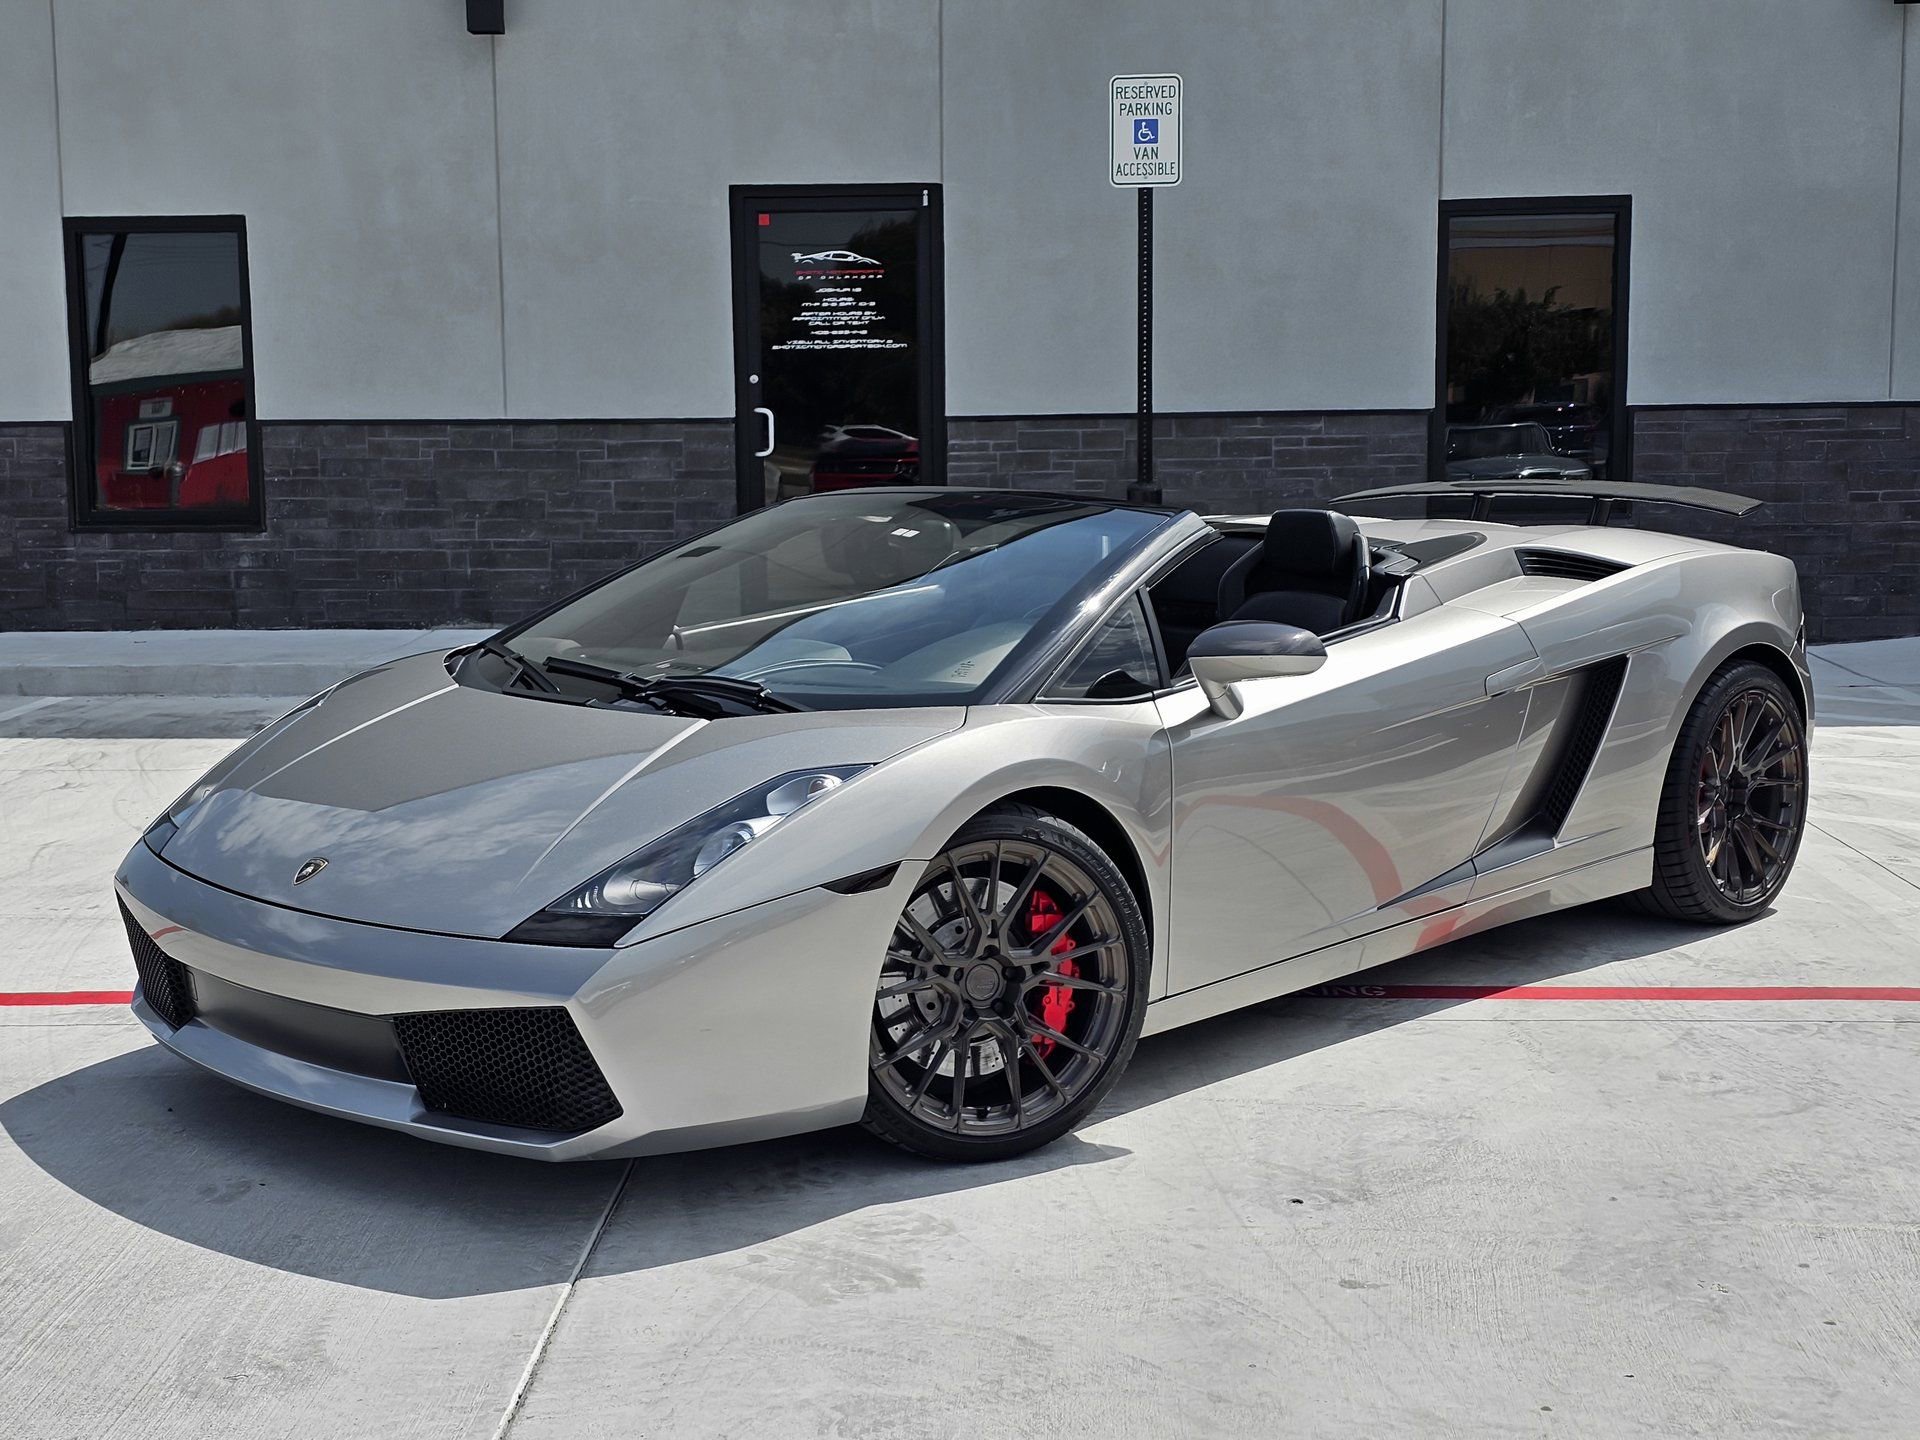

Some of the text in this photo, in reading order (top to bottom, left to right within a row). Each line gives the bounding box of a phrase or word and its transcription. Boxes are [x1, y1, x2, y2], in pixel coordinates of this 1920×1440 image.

[1116, 85, 1176, 99] RESERVED
[1119, 102, 1172, 116] PARKING
[1133, 146, 1159, 160] VAN
[1115, 162, 1176, 176] ACCESSIBLE
